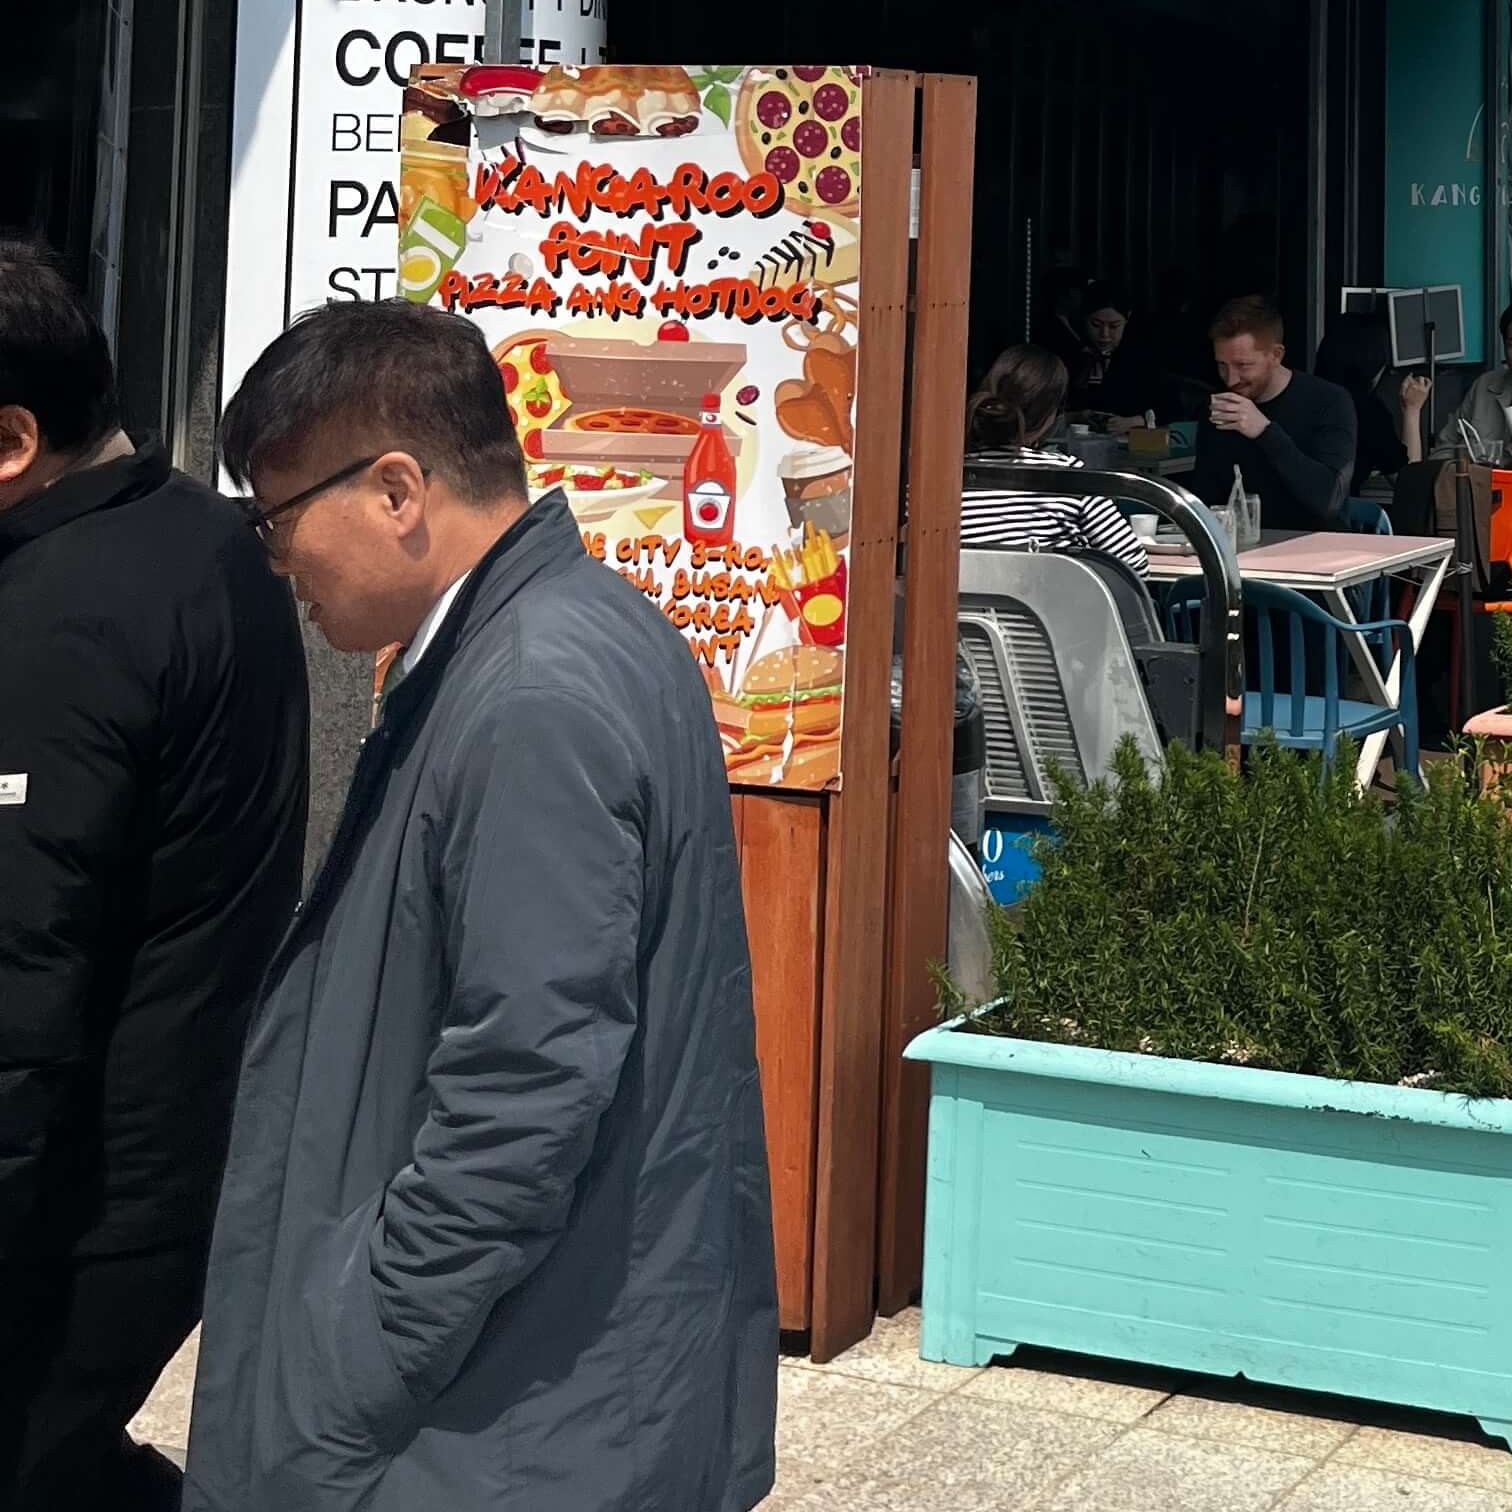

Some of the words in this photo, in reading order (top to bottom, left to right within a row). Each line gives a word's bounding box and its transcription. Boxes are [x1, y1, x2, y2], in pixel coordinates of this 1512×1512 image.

[332, 113, 401, 153] BE
[475, 155, 785, 222] KANGAROO
[539, 221, 702, 284] POINT
[439, 271, 563, 316] PIZZA
[650, 277, 822, 325] HOTDOG
[616, 535, 682, 567] CITY
